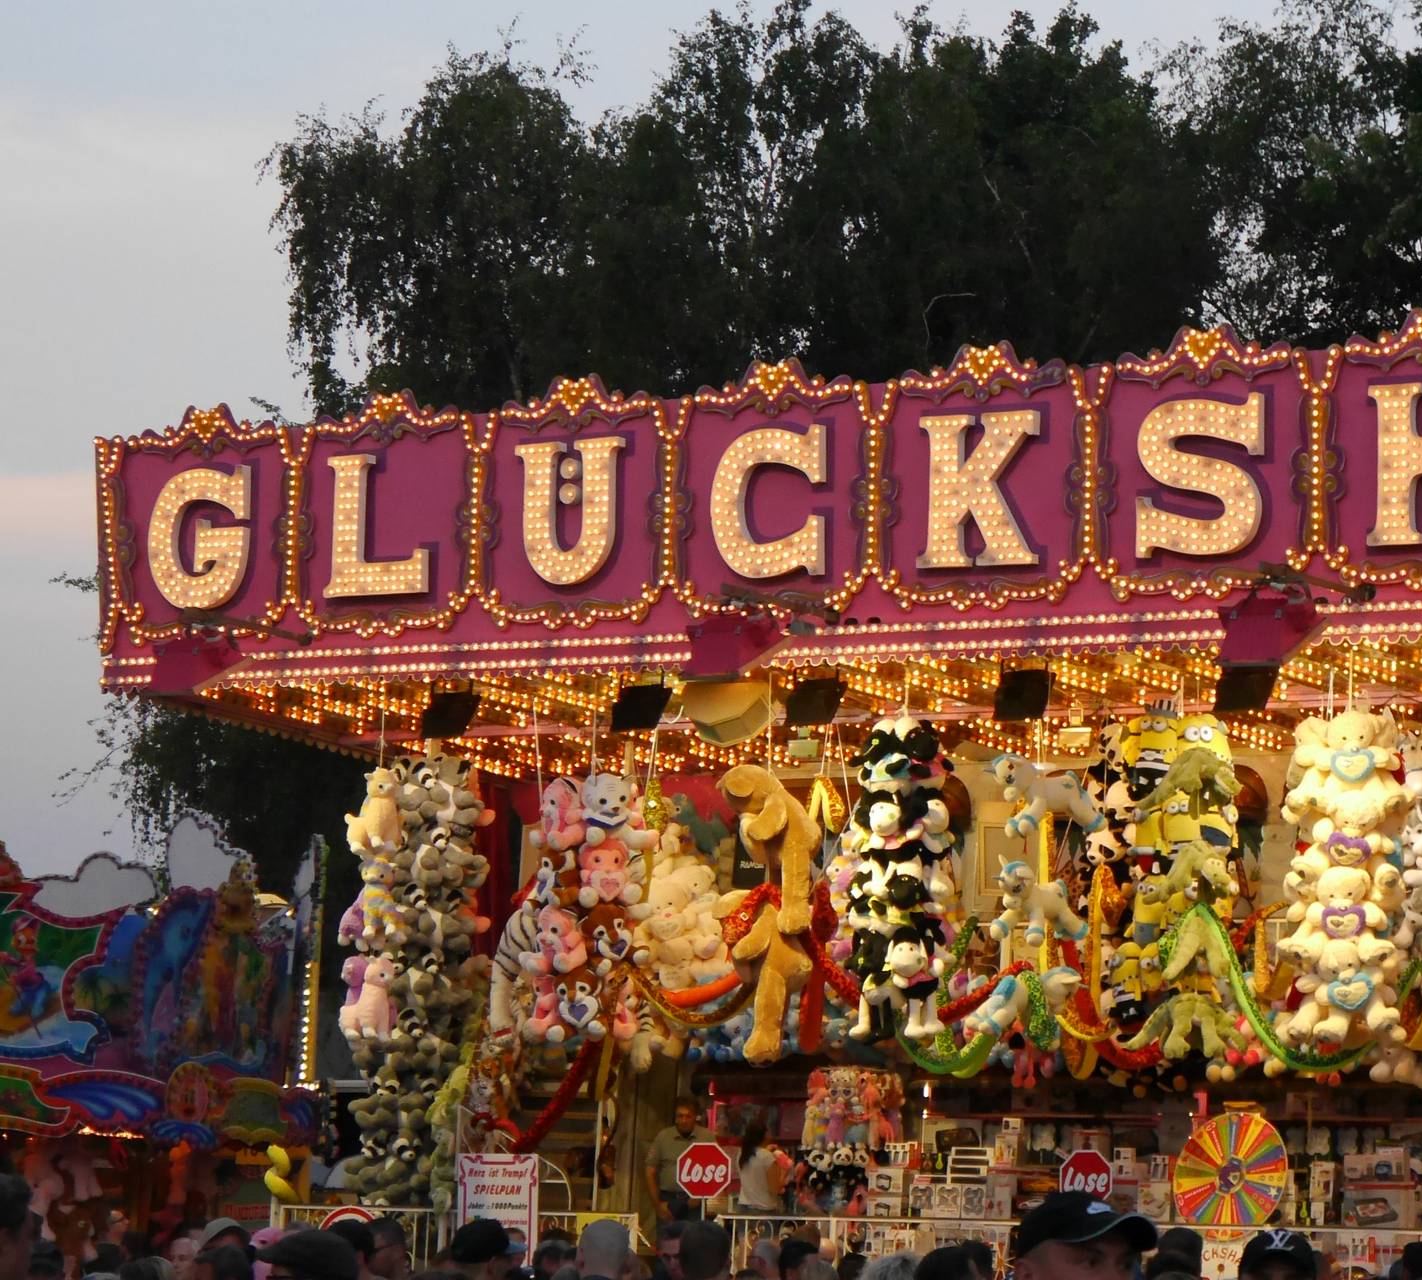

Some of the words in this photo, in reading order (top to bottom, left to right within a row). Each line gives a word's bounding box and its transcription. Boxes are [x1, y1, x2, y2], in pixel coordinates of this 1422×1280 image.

[468, 1168, 485, 1177] Herz
[489, 1168, 499, 1177] ist
[502, 1168, 528, 1180] Trumpf
[681, 1158, 727, 1183] Lose
[1063, 1166, 1108, 1192] Lose
[473, 1184, 521, 1195] SPIELPLAN
[1203, 1247, 1241, 1265] CKSHA
